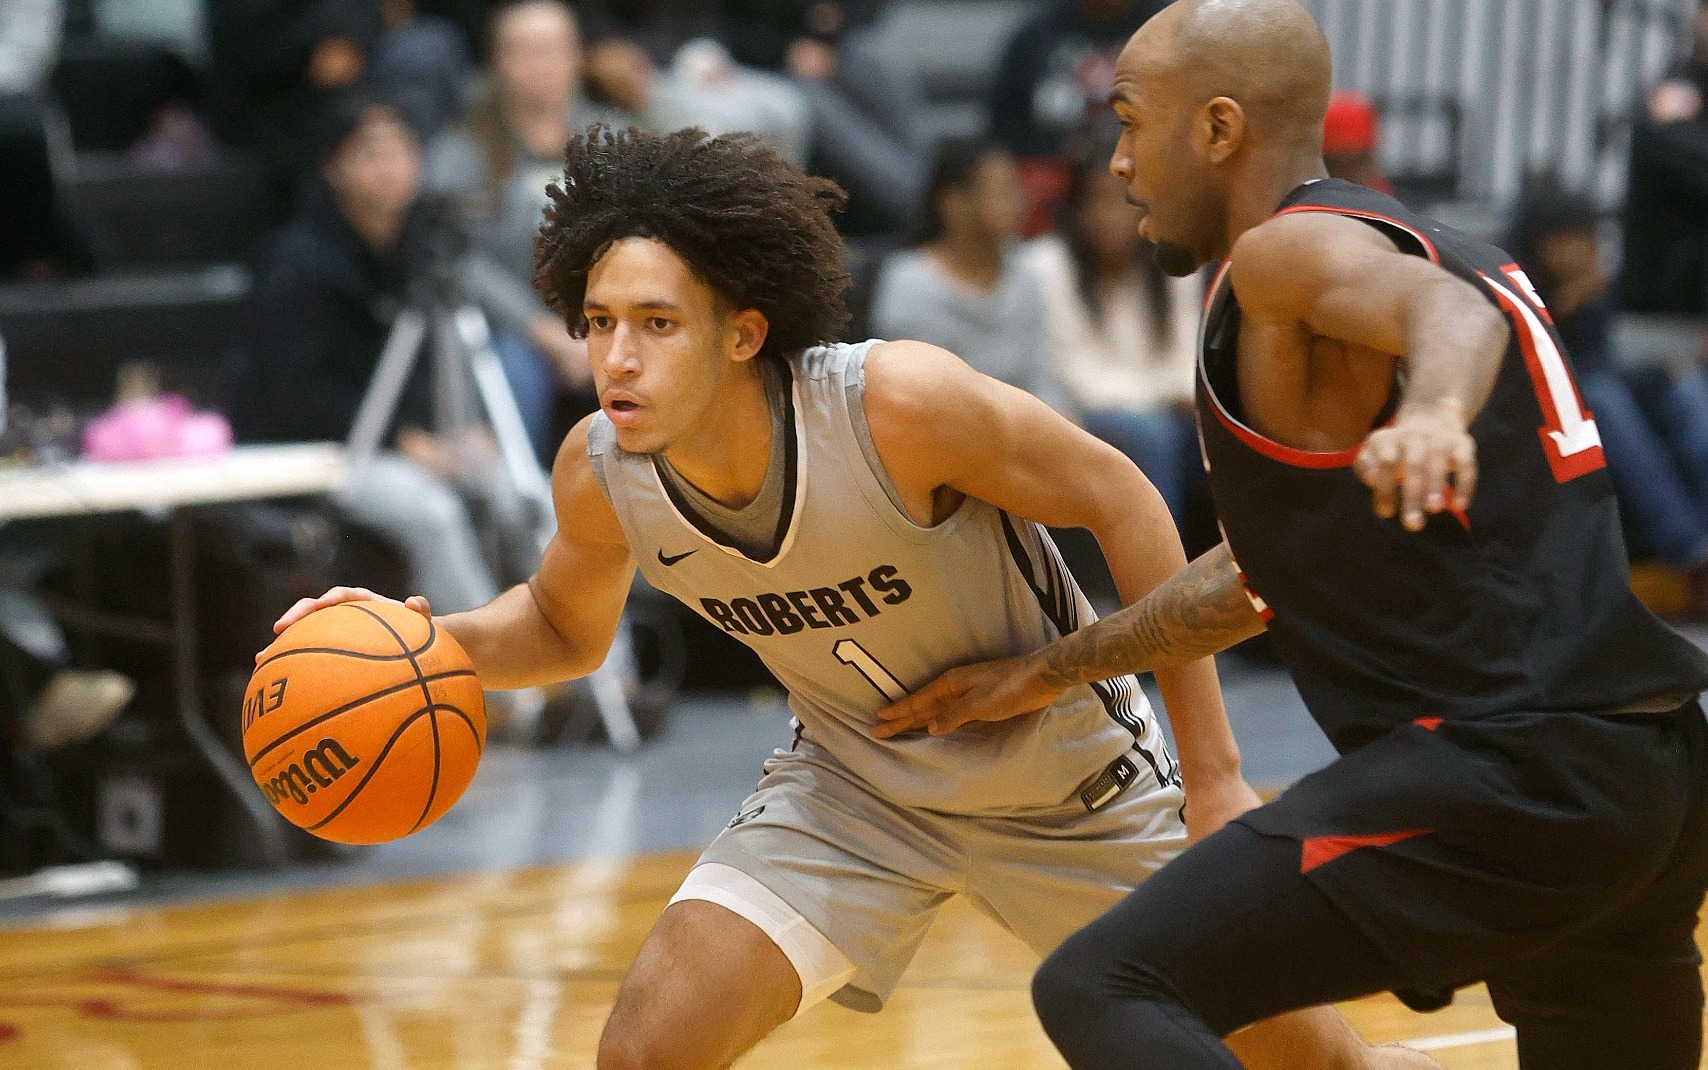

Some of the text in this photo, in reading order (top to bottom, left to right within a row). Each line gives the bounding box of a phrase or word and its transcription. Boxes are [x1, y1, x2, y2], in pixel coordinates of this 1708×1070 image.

[1474, 262, 1607, 484] 1
[699, 564, 913, 636] ROBERTS
[831, 638, 913, 704] 1
[261, 738, 360, 806] Wilso
[1117, 764, 1130, 780] M
